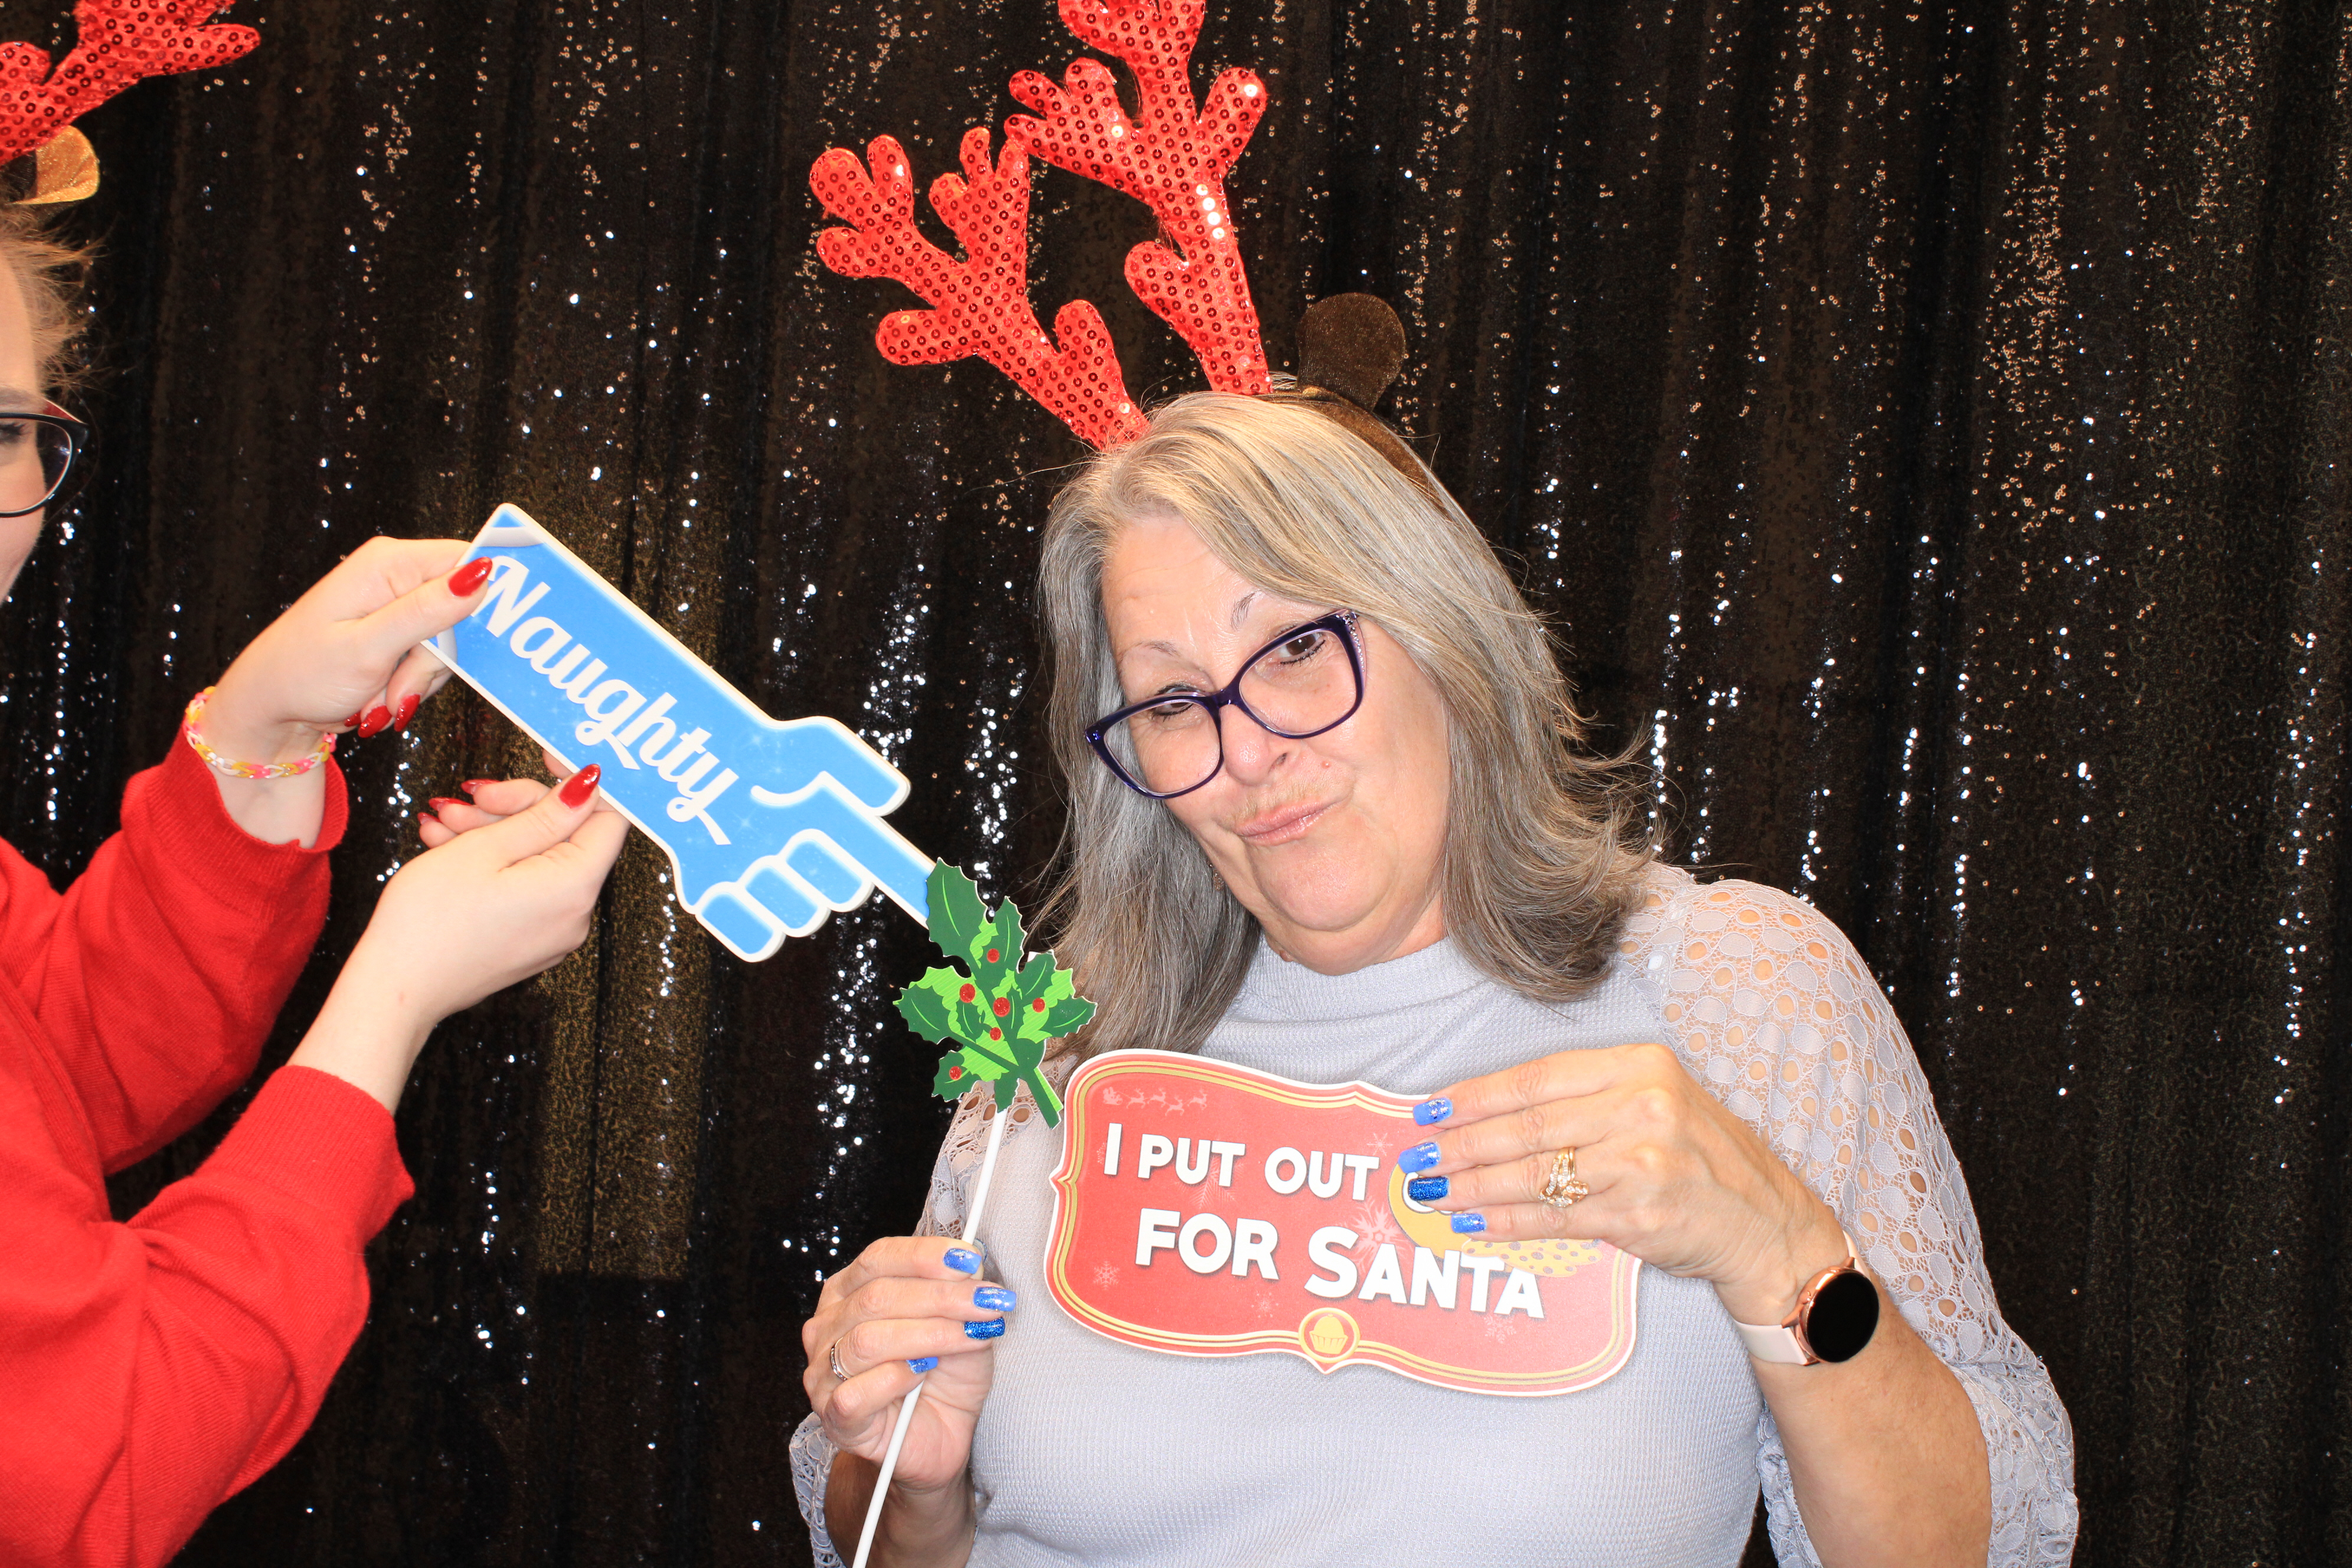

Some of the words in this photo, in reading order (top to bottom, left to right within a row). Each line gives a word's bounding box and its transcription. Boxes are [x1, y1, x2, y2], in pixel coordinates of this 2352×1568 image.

[472, 556, 739, 845] Naughty
[1103, 1122, 1122, 1175] I
[1138, 1133, 1246, 1187] PUT
[1264, 1146, 1380, 1201] OUT
[1135, 1207, 1279, 1280] FOR
[1305, 1226, 1544, 1318] SANTA
